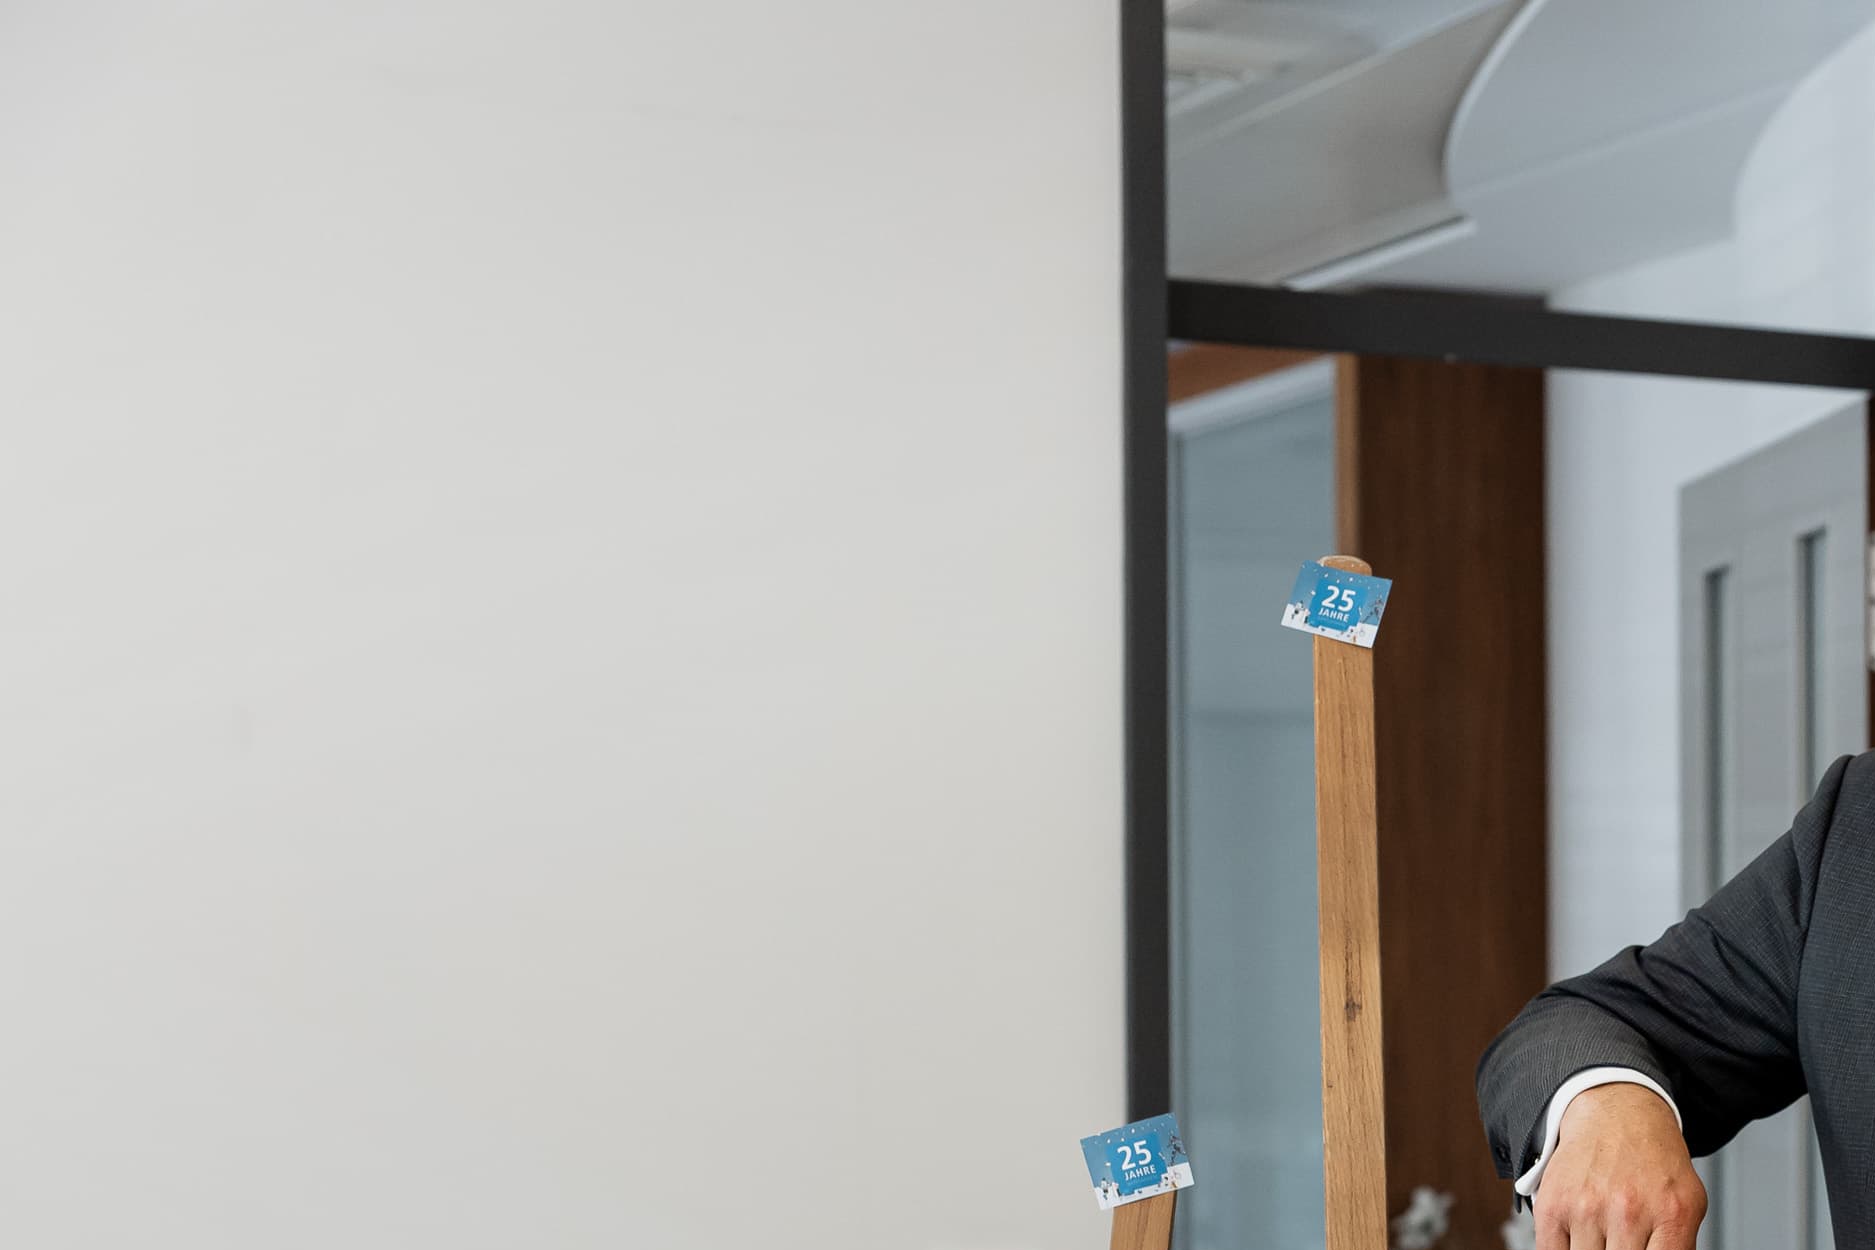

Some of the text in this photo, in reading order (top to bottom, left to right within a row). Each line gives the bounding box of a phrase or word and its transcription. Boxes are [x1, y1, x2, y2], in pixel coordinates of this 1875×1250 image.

[1321, 585, 1356, 612] 25
[1318, 607, 1350, 623] JAHRE
[1117, 1139, 1152, 1170] 25
[1124, 1164, 1157, 1181] JAHRE
